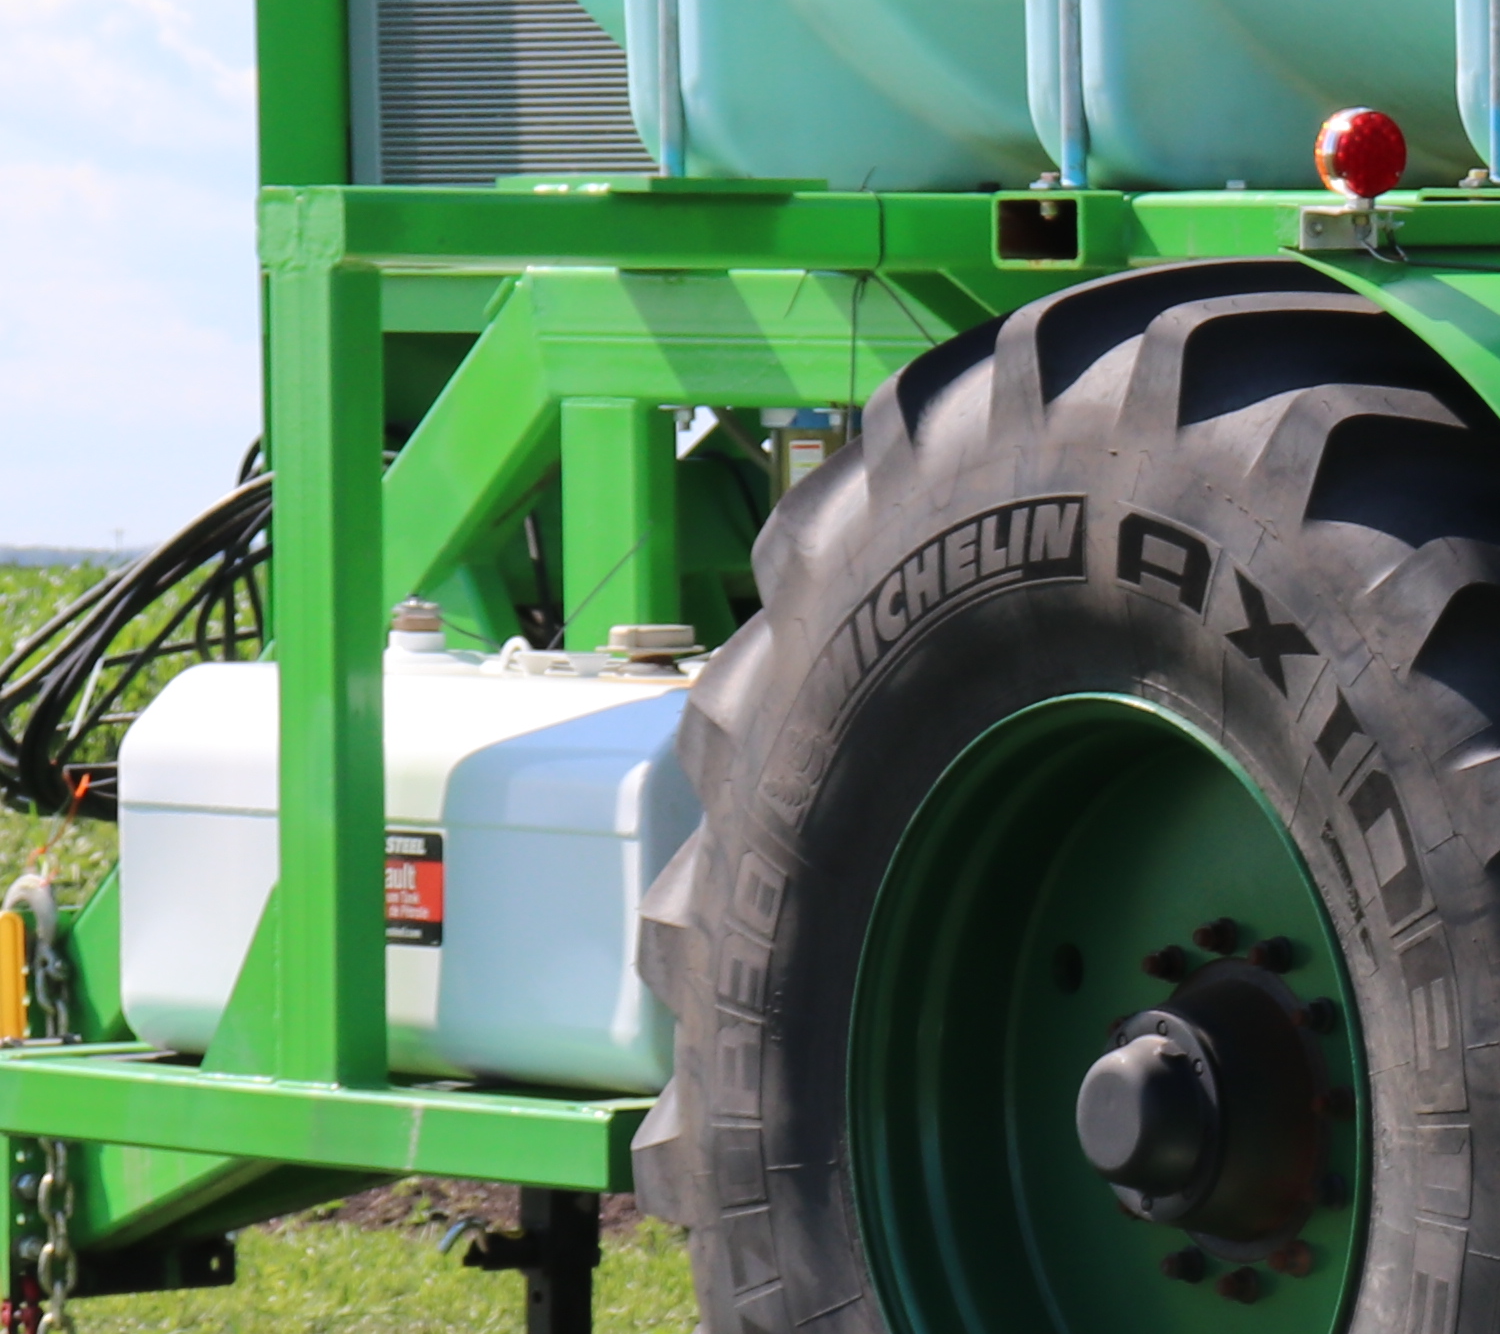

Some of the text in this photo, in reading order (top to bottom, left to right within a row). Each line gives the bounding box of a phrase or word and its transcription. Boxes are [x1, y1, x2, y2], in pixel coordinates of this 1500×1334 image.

[804, 501, 1081, 729] MICHELIN
[385, 835, 427, 855] STEEL
[385, 862, 416, 890] ault
